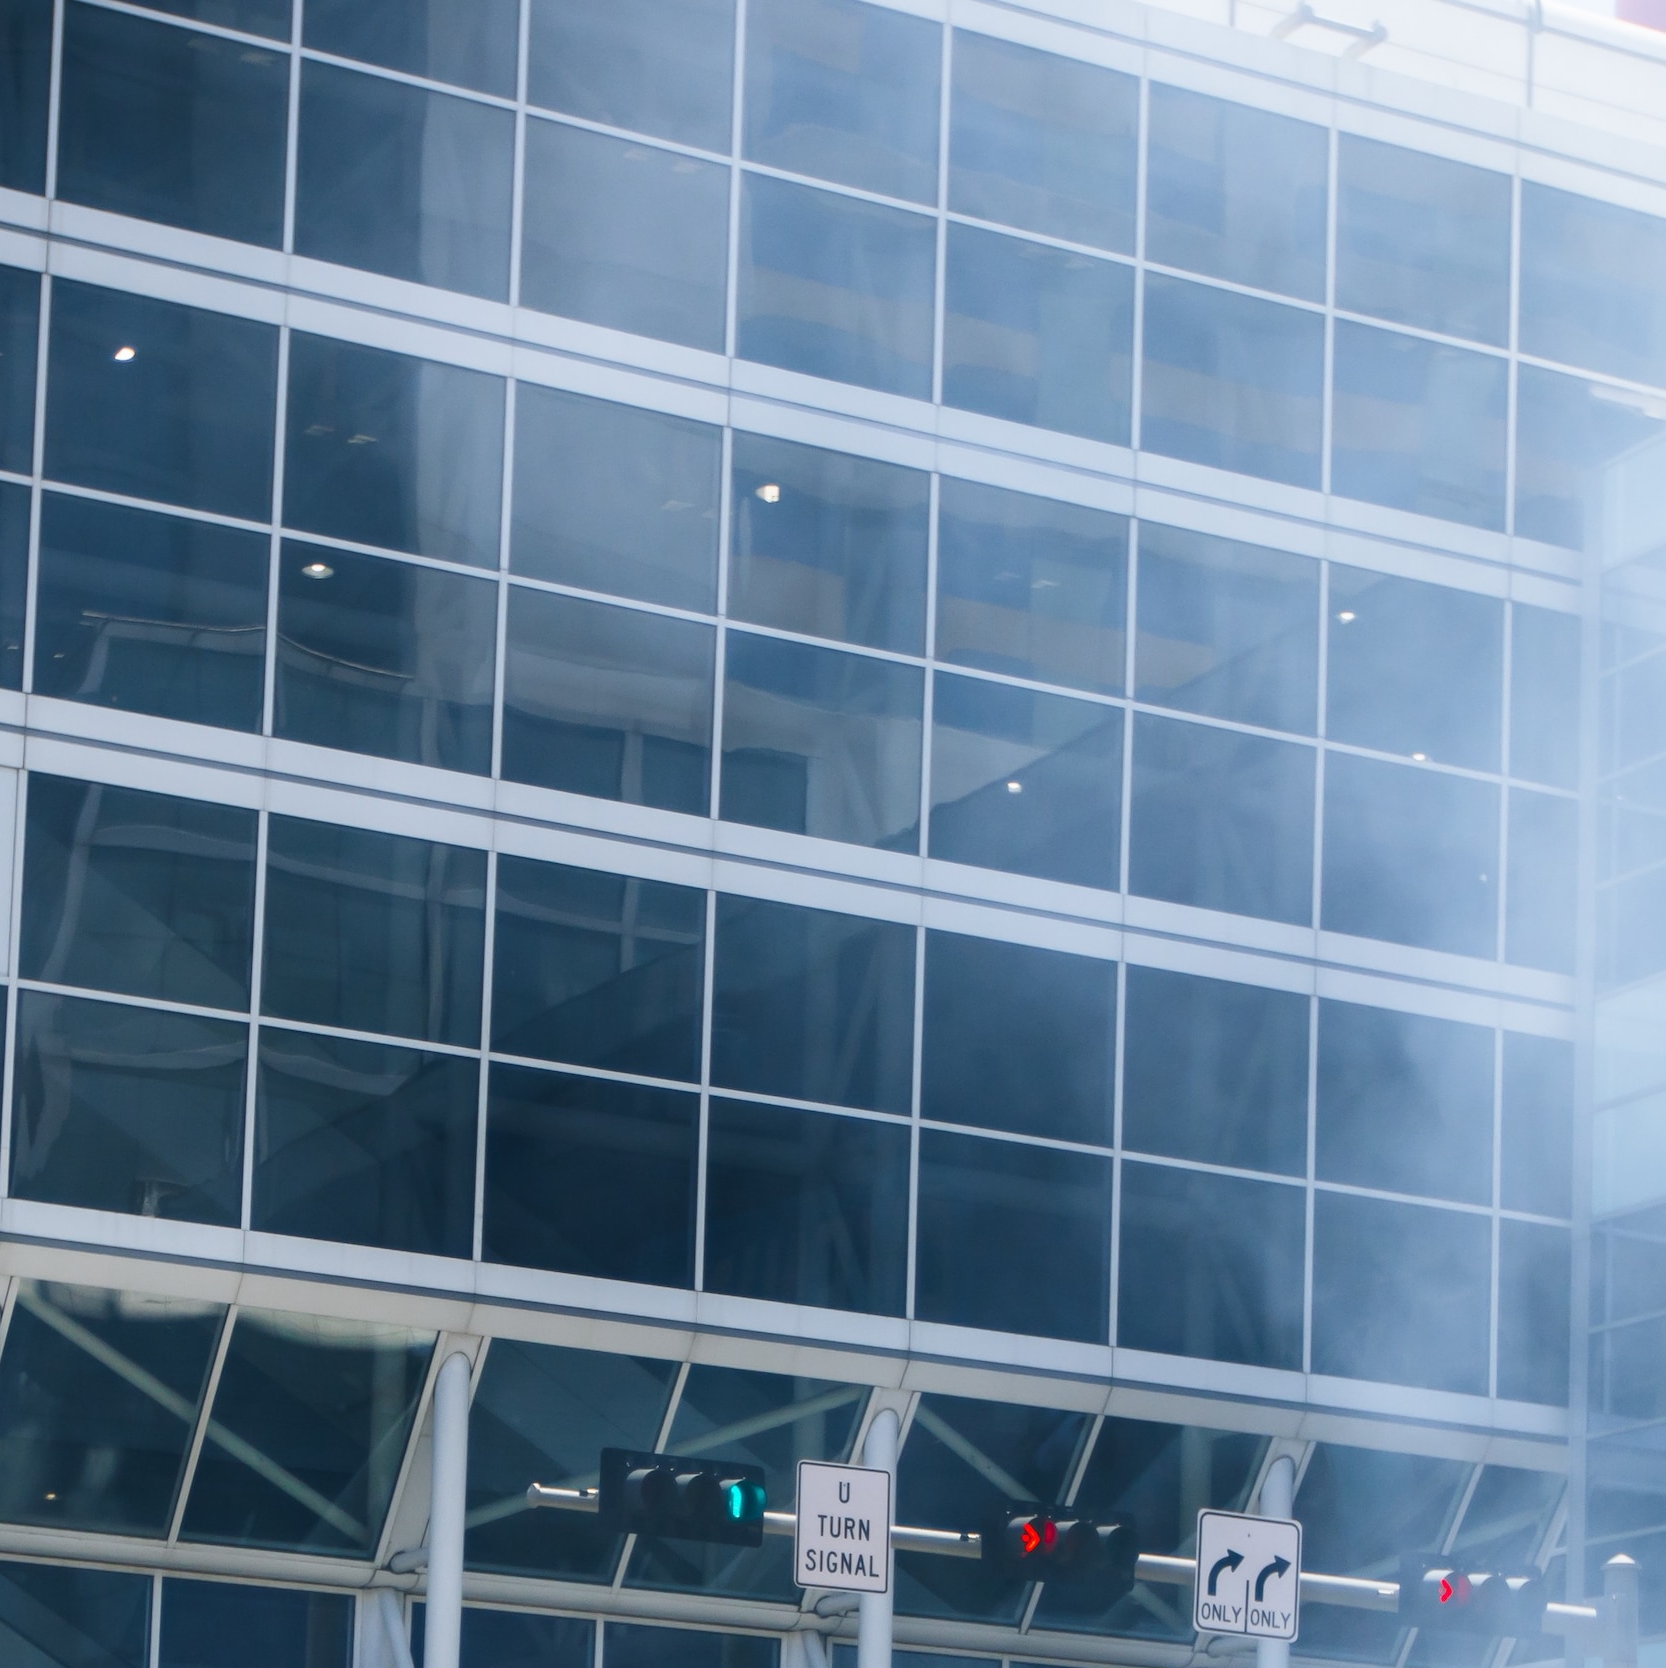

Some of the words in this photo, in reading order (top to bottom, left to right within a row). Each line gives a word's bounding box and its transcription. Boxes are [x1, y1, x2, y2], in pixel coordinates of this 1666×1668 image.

[837, 1481, 852, 1505] U
[817, 1514, 871, 1542] TURN
[804, 1549, 880, 1579] SIGNAL
[1201, 1602, 1242, 1626] ONLY
[1250, 1609, 1291, 1631] ONLY
